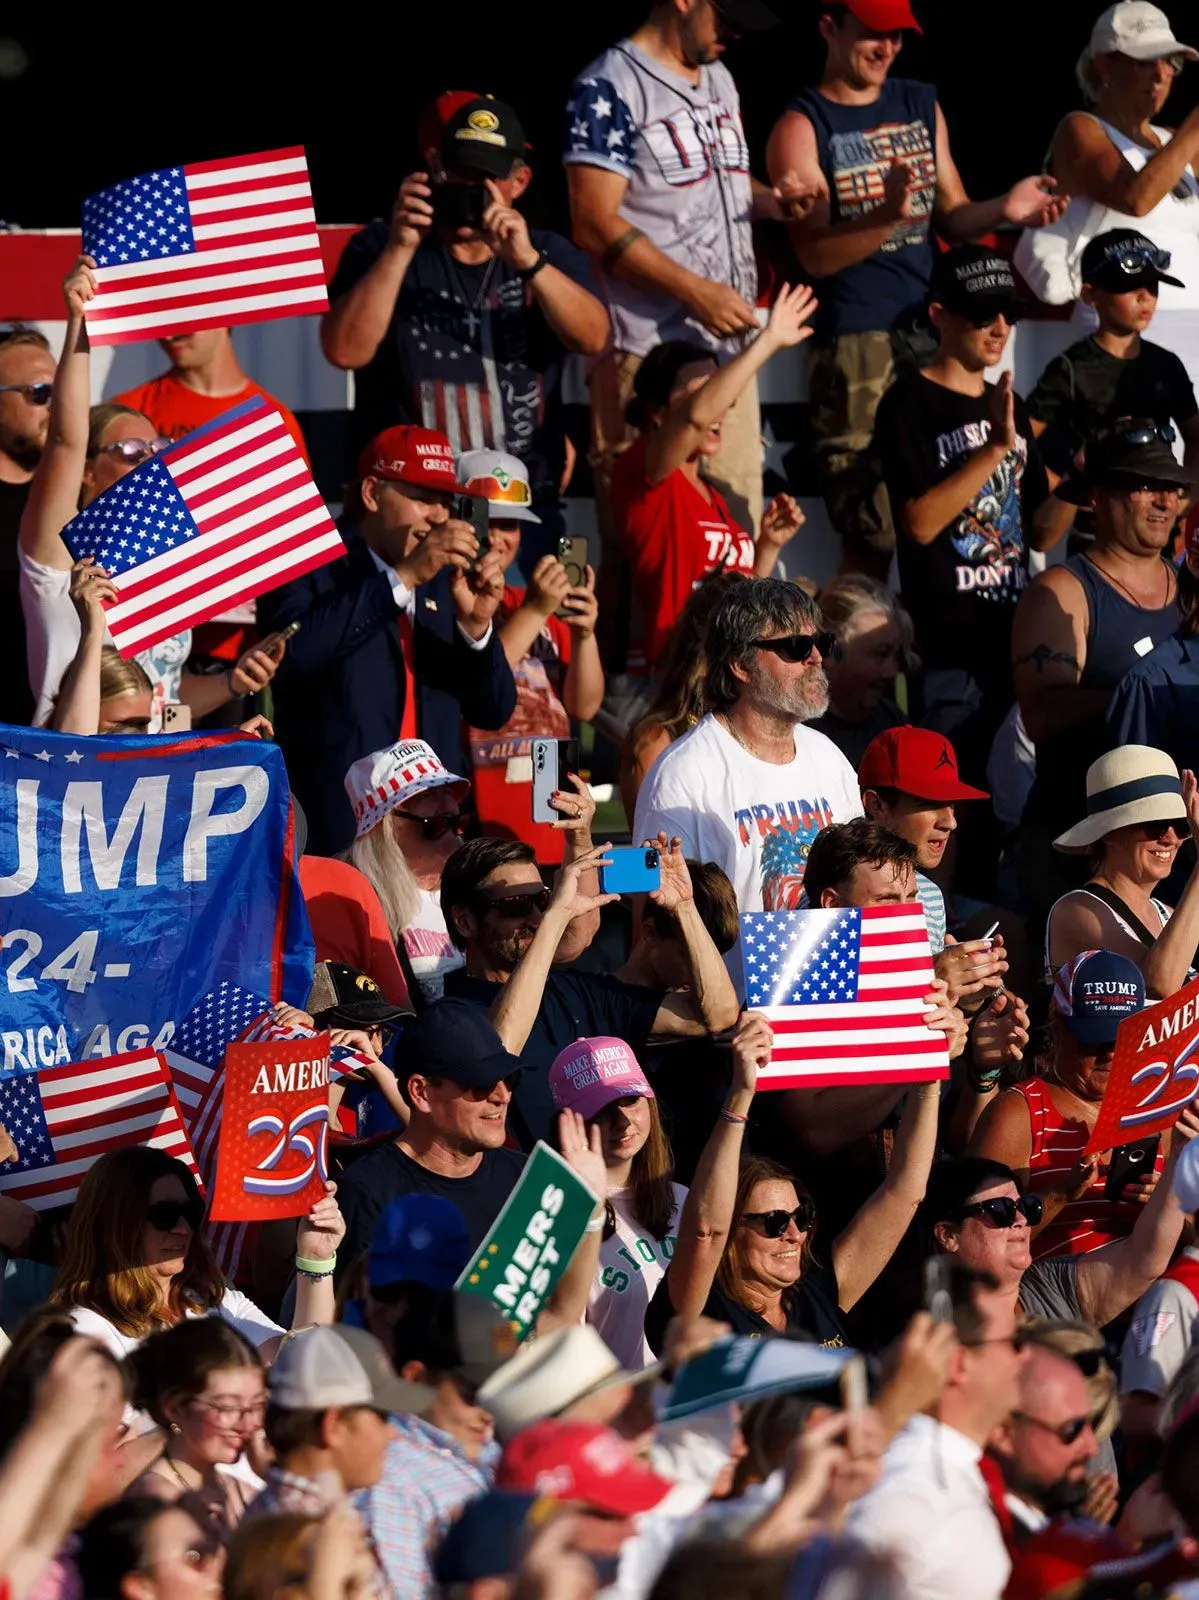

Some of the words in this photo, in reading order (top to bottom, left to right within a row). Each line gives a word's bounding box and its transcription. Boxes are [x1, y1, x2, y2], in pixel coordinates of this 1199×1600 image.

[888, 128, 930, 158] MAY
[850, 173, 870, 197] IT
[415, 444, 444, 457] MAKE
[422, 458, 449, 472] GREAT
[390, 742, 426, 761] Trump
[490, 742, 514, 760] ALL
[734, 796, 834, 849] TRUMP
[1084, 981, 1138, 996] TRUMP
[81, 1019, 177, 1058] AGA
[563, 1055, 591, 1081] MAKE
[591, 1046, 631, 1067] AMERICA
[572, 1067, 604, 1091] GREAT
[603, 1060, 631, 1079] AGAIN
[491, 1183, 566, 1310] MERS
[599, 1234, 678, 1294] SIOU
[514, 1235, 561, 1326] RST
